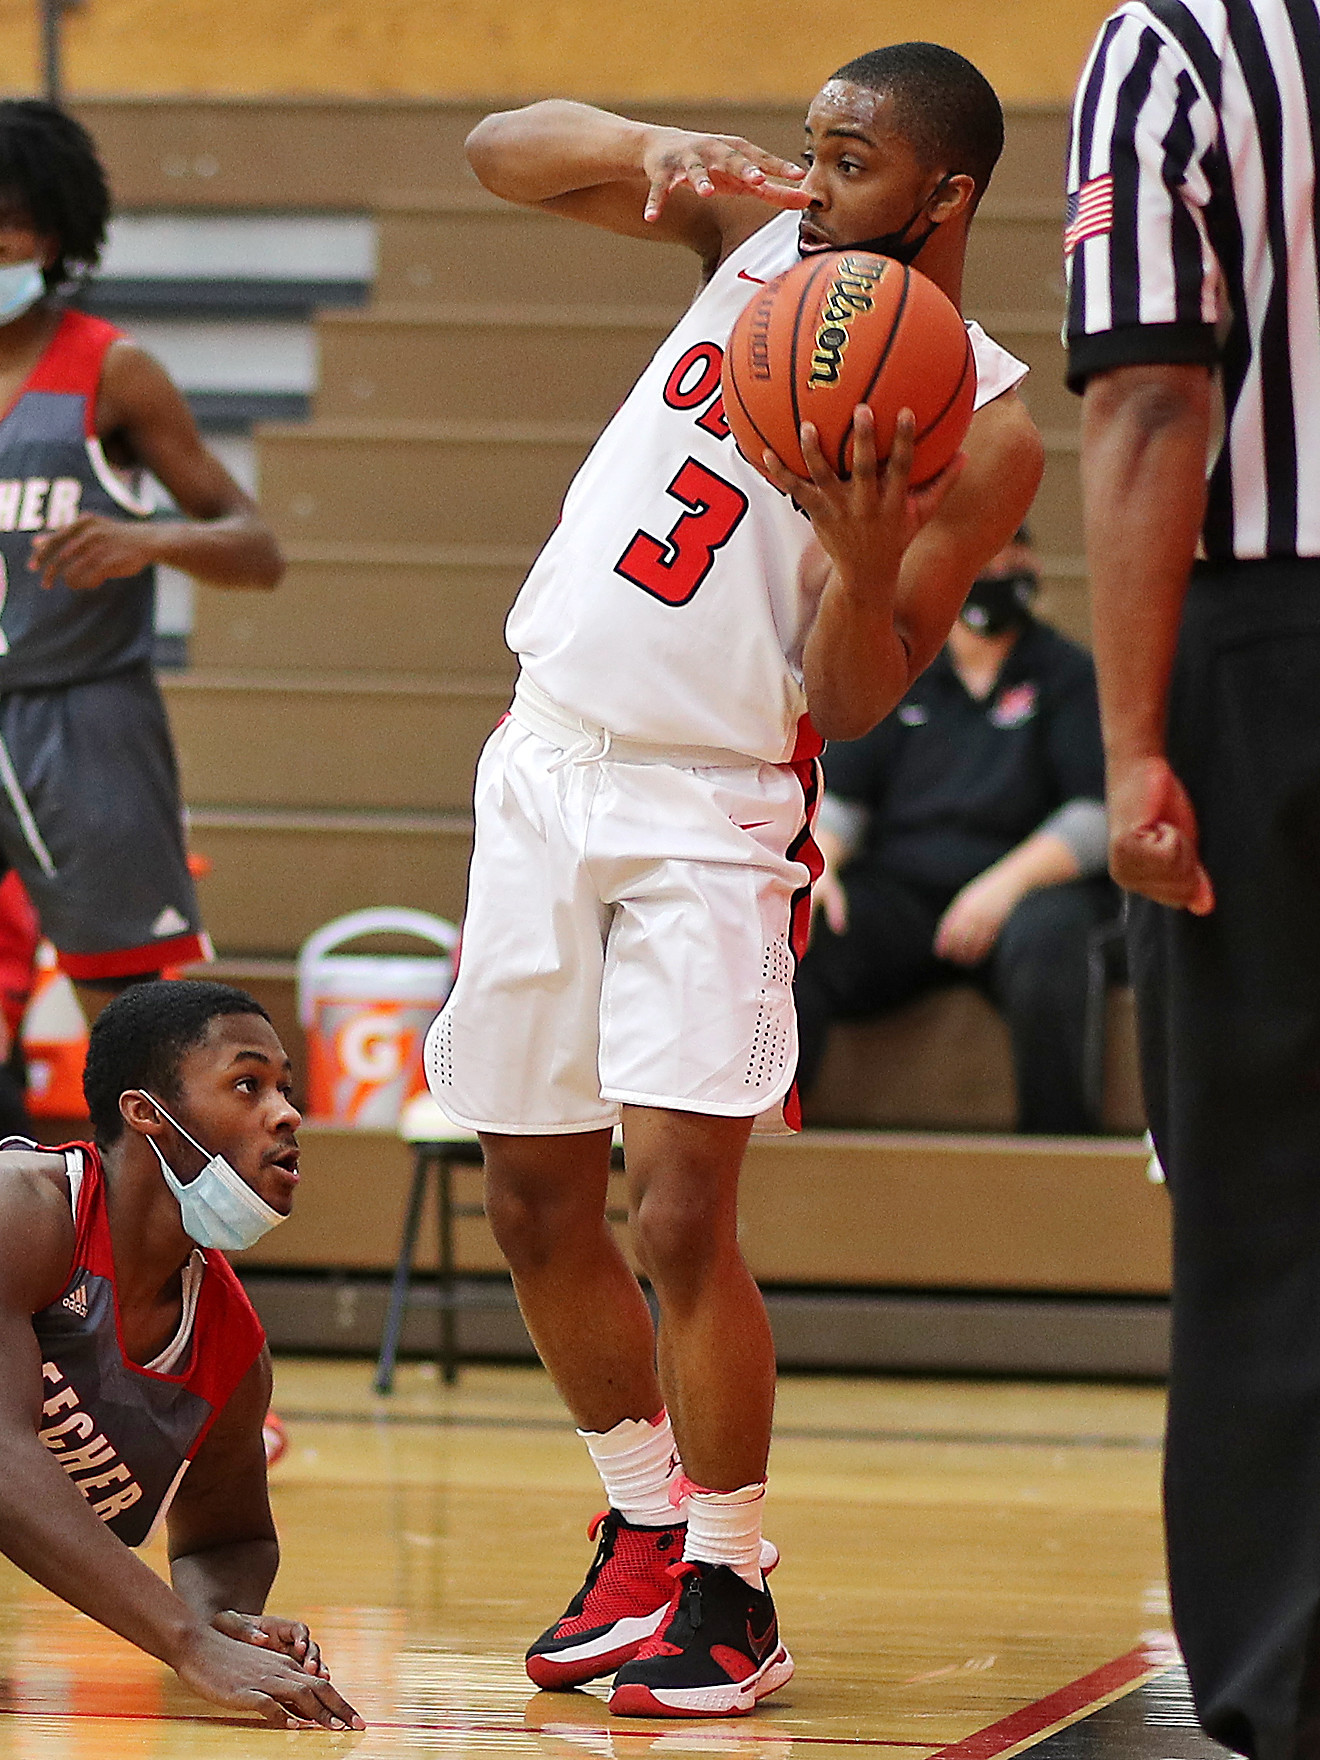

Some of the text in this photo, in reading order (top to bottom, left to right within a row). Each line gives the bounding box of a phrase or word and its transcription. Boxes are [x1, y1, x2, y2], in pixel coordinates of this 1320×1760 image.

[663, 341, 732, 441] OL
[806, 257, 890, 391] Wilson
[614, 455, 750, 608] 3
[37, 1361, 144, 1522] ECHER
